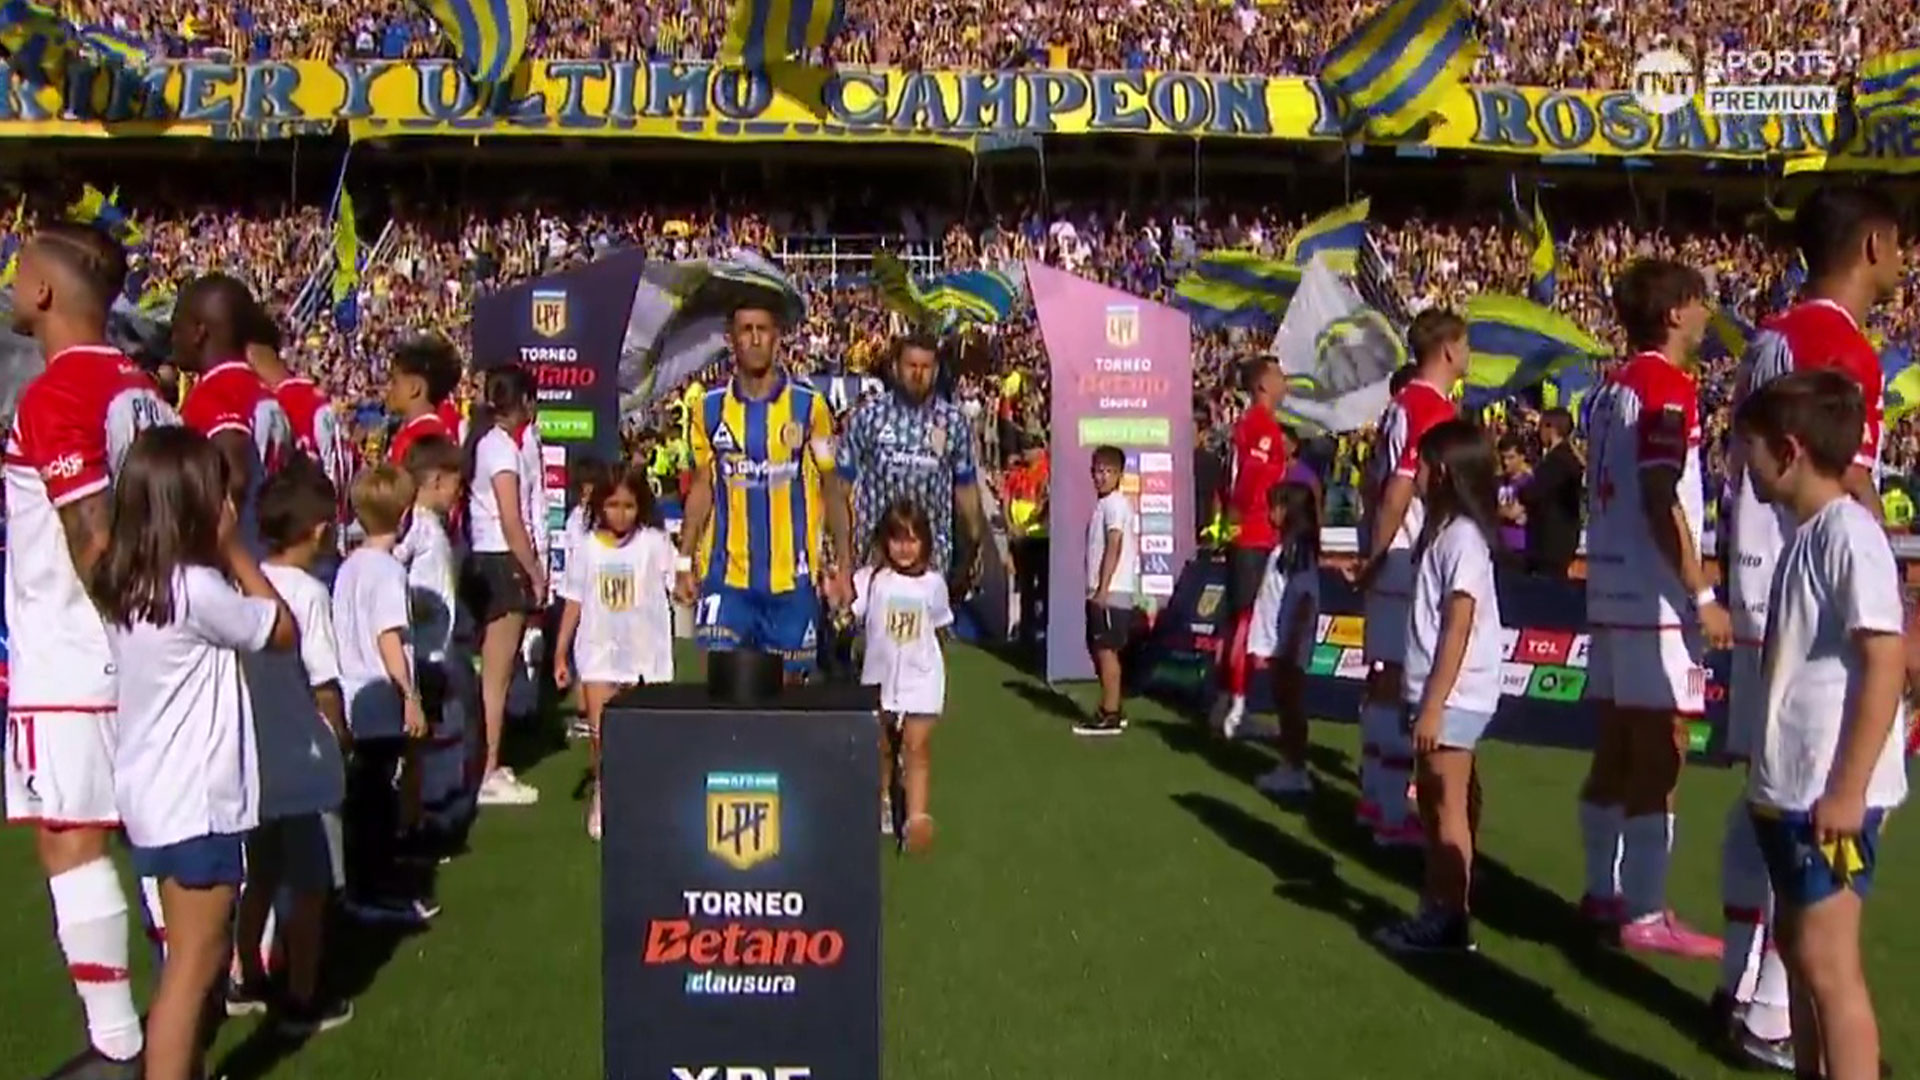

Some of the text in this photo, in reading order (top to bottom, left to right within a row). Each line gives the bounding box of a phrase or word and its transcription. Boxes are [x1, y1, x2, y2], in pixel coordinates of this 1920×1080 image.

[333, 58, 393, 118] Y
[831, 69, 1274, 134] CAMPEON
[520, 347, 578, 363] TORNEO
[1095, 357, 1152, 372] TORNEO
[1527, 639, 1559, 656] TCL
[717, 802, 770, 856] LPF
[683, 891, 804, 917] TORNEO
[643, 919, 845, 966] Betano
[687, 969, 796, 994] clausura
